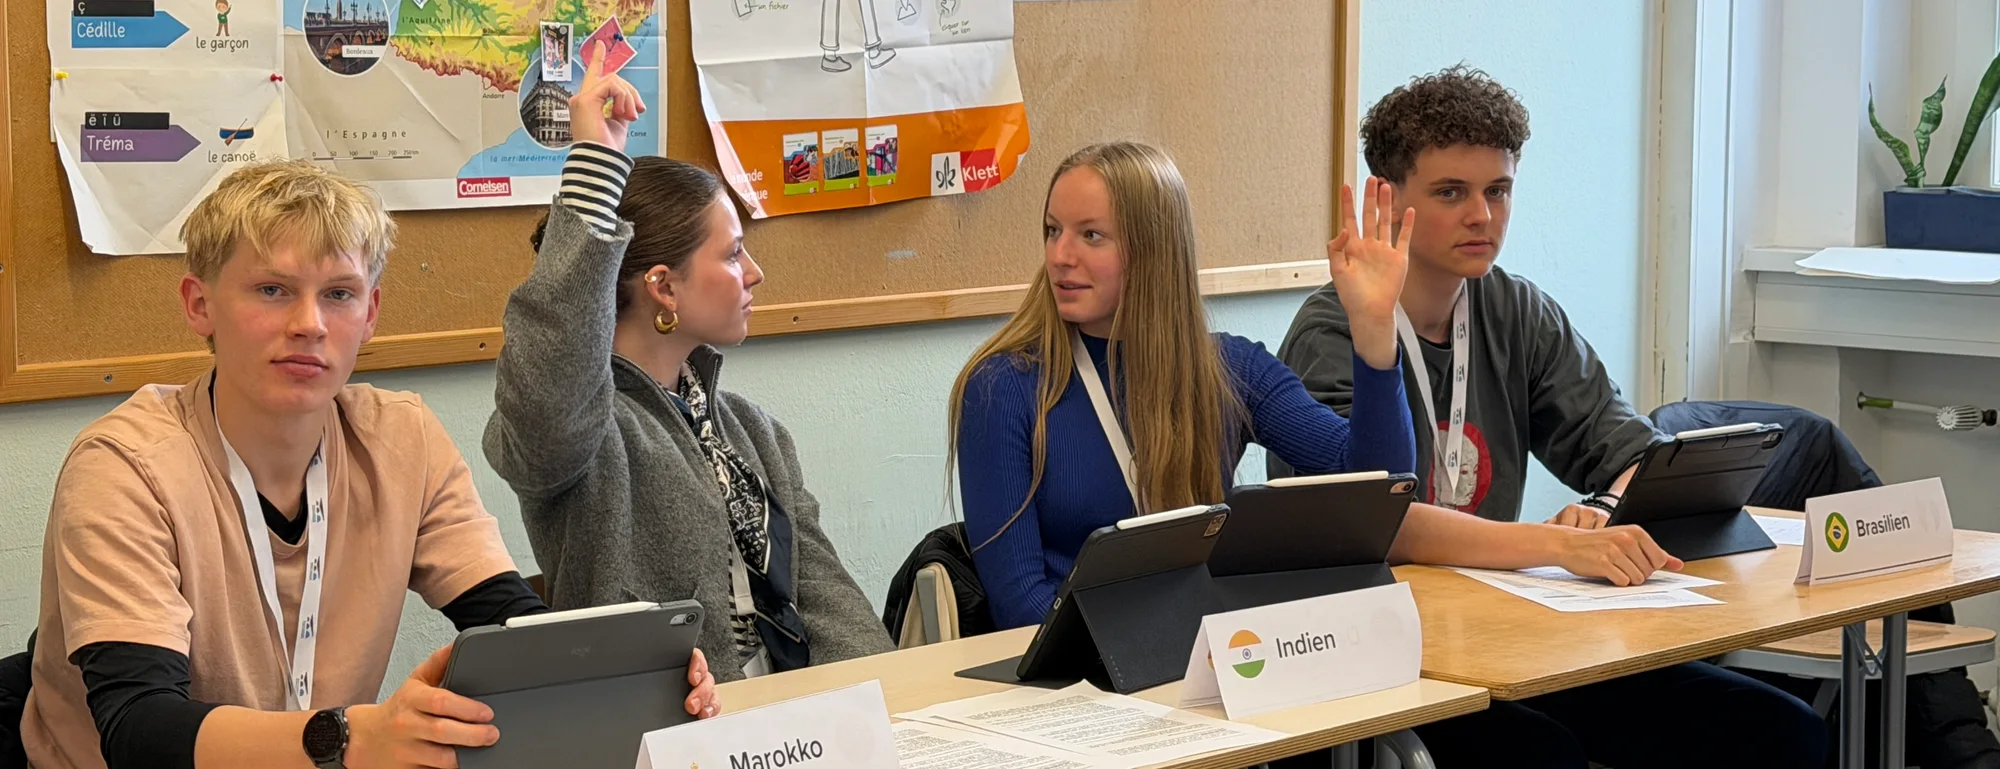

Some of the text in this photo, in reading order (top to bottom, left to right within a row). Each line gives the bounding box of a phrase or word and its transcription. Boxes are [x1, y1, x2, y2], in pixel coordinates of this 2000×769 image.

[77, 22, 126, 38] Cédille
[196, 36, 249, 52] le garçon
[87, 135, 135, 151] Tréma
[208, 150, 257, 163] le canoë
[962, 164, 999, 182] Klett
[459, 180, 510, 196] Cornelsen
[1855, 514, 1911, 537] Brasilien
[1276, 632, 1336, 658] Indien
[729, 738, 823, 769] Marokko
